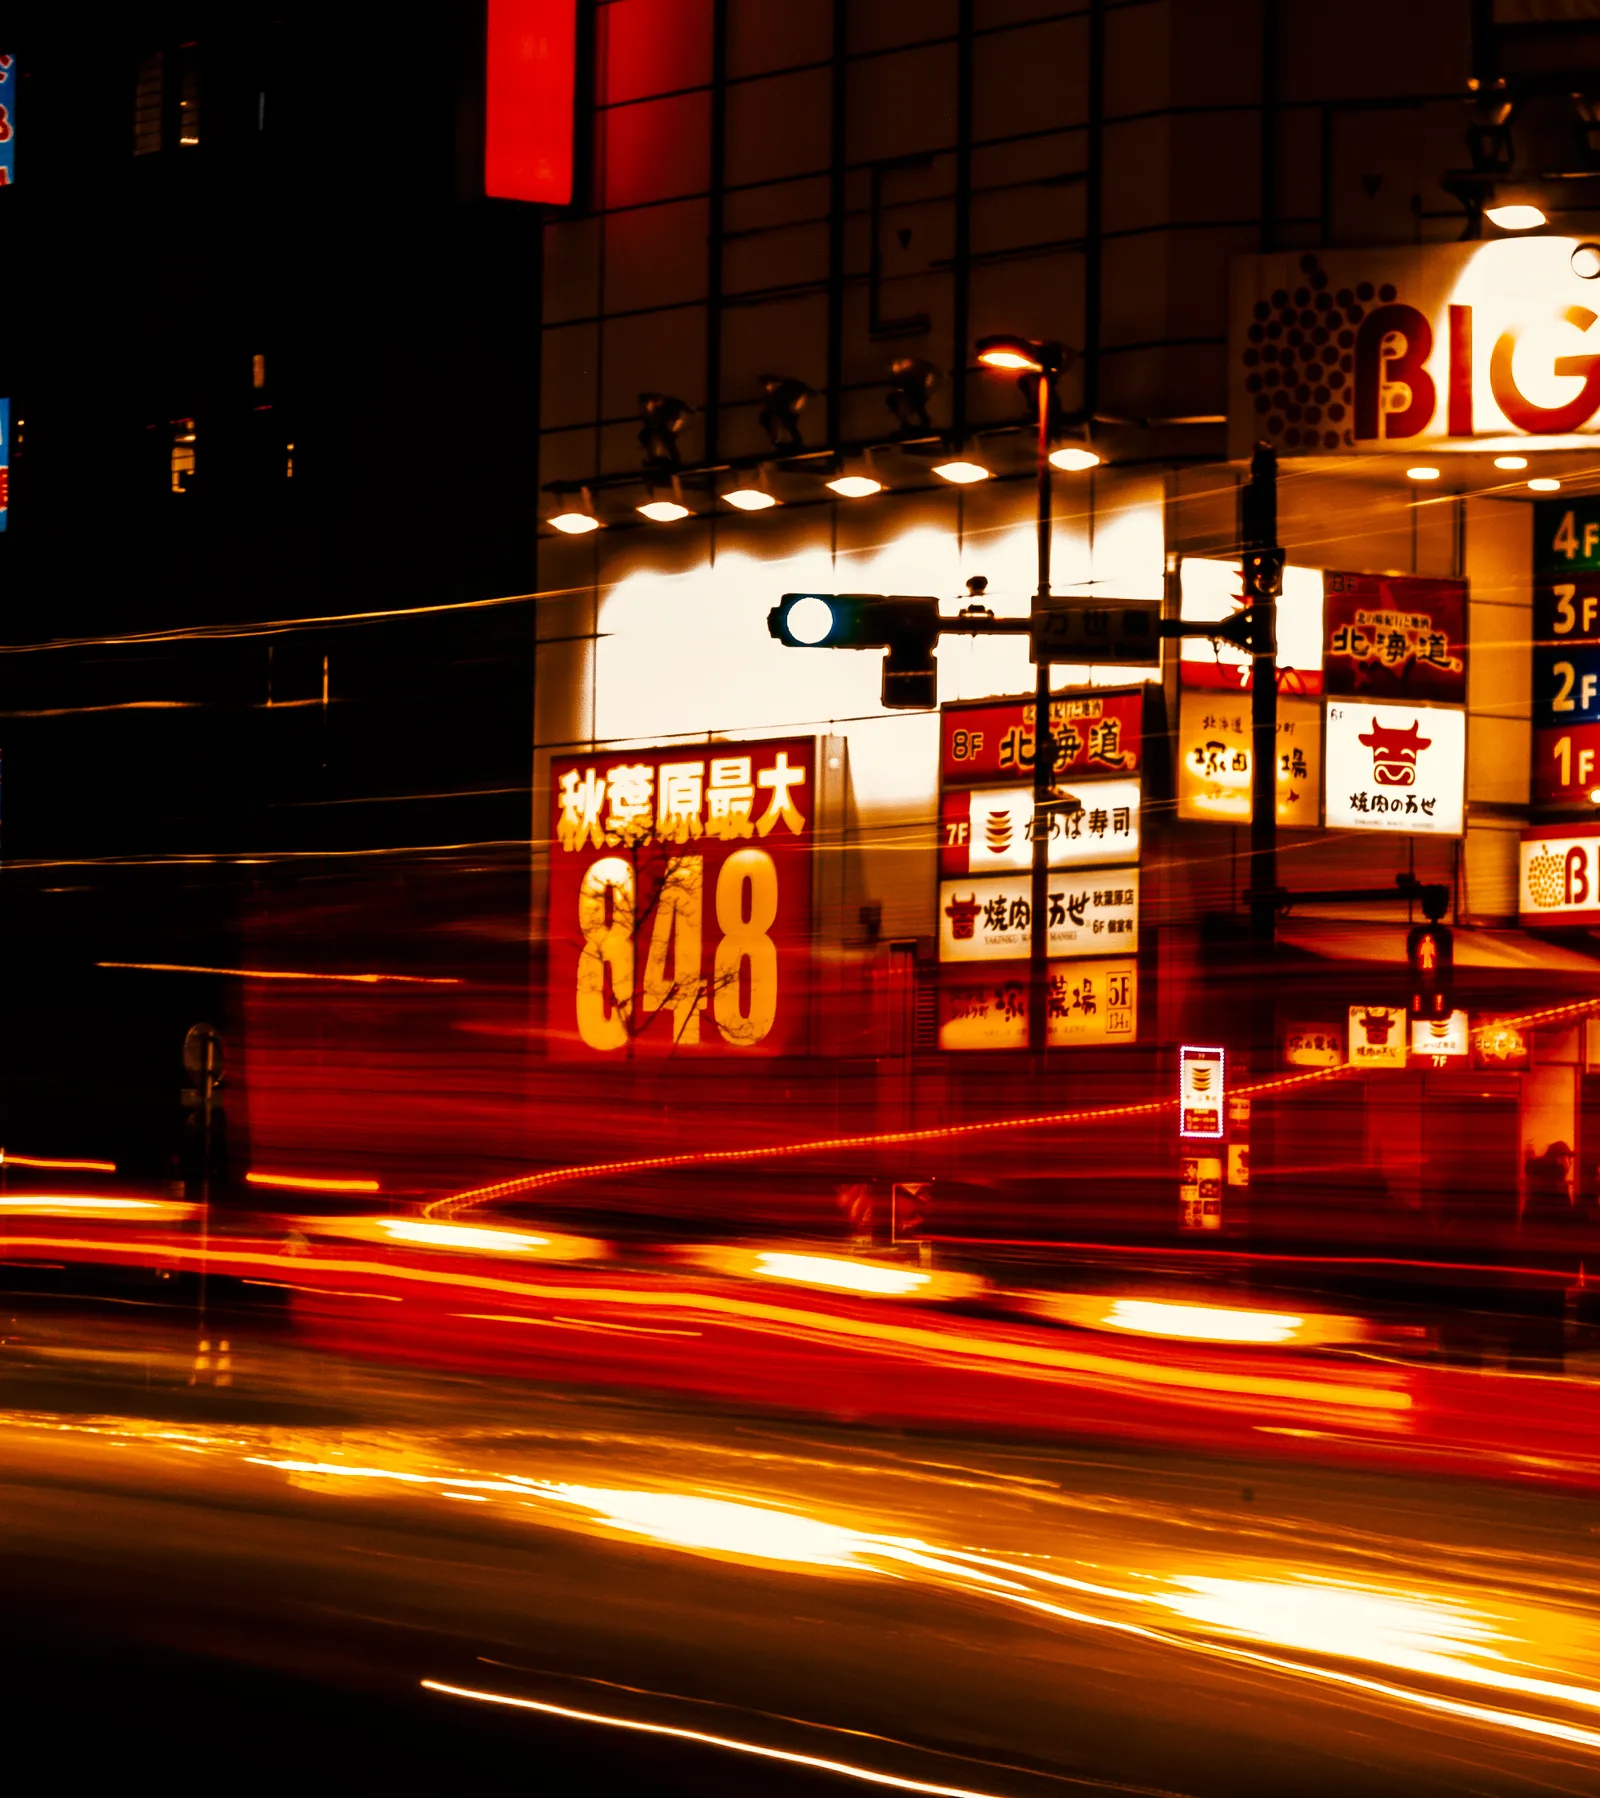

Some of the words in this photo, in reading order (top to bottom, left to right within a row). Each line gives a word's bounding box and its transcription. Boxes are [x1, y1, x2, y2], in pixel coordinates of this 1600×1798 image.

[1553, 511, 1600, 559] 4F
[1552, 584, 1598, 634] 3F
[1333, 627, 1453, 669] 北海道
[1552, 662, 1598, 712] 2F
[952, 730, 983, 761] 8F
[1194, 740, 1308, 779] 塚田場
[1553, 737, 1595, 785] 1F
[556, 752, 807, 853] 秋葉原最大
[1349, 790, 1437, 816] 焼肉の万世
[946, 823, 969, 846] 7F
[983, 890, 1091, 932] 焼肉万世
[575, 847, 779, 1052] 848
[994, 977, 1097, 1023] 塚農場
[1109, 976, 1130, 1007] 5F
[1431, 1055, 1447, 1067] 7F
